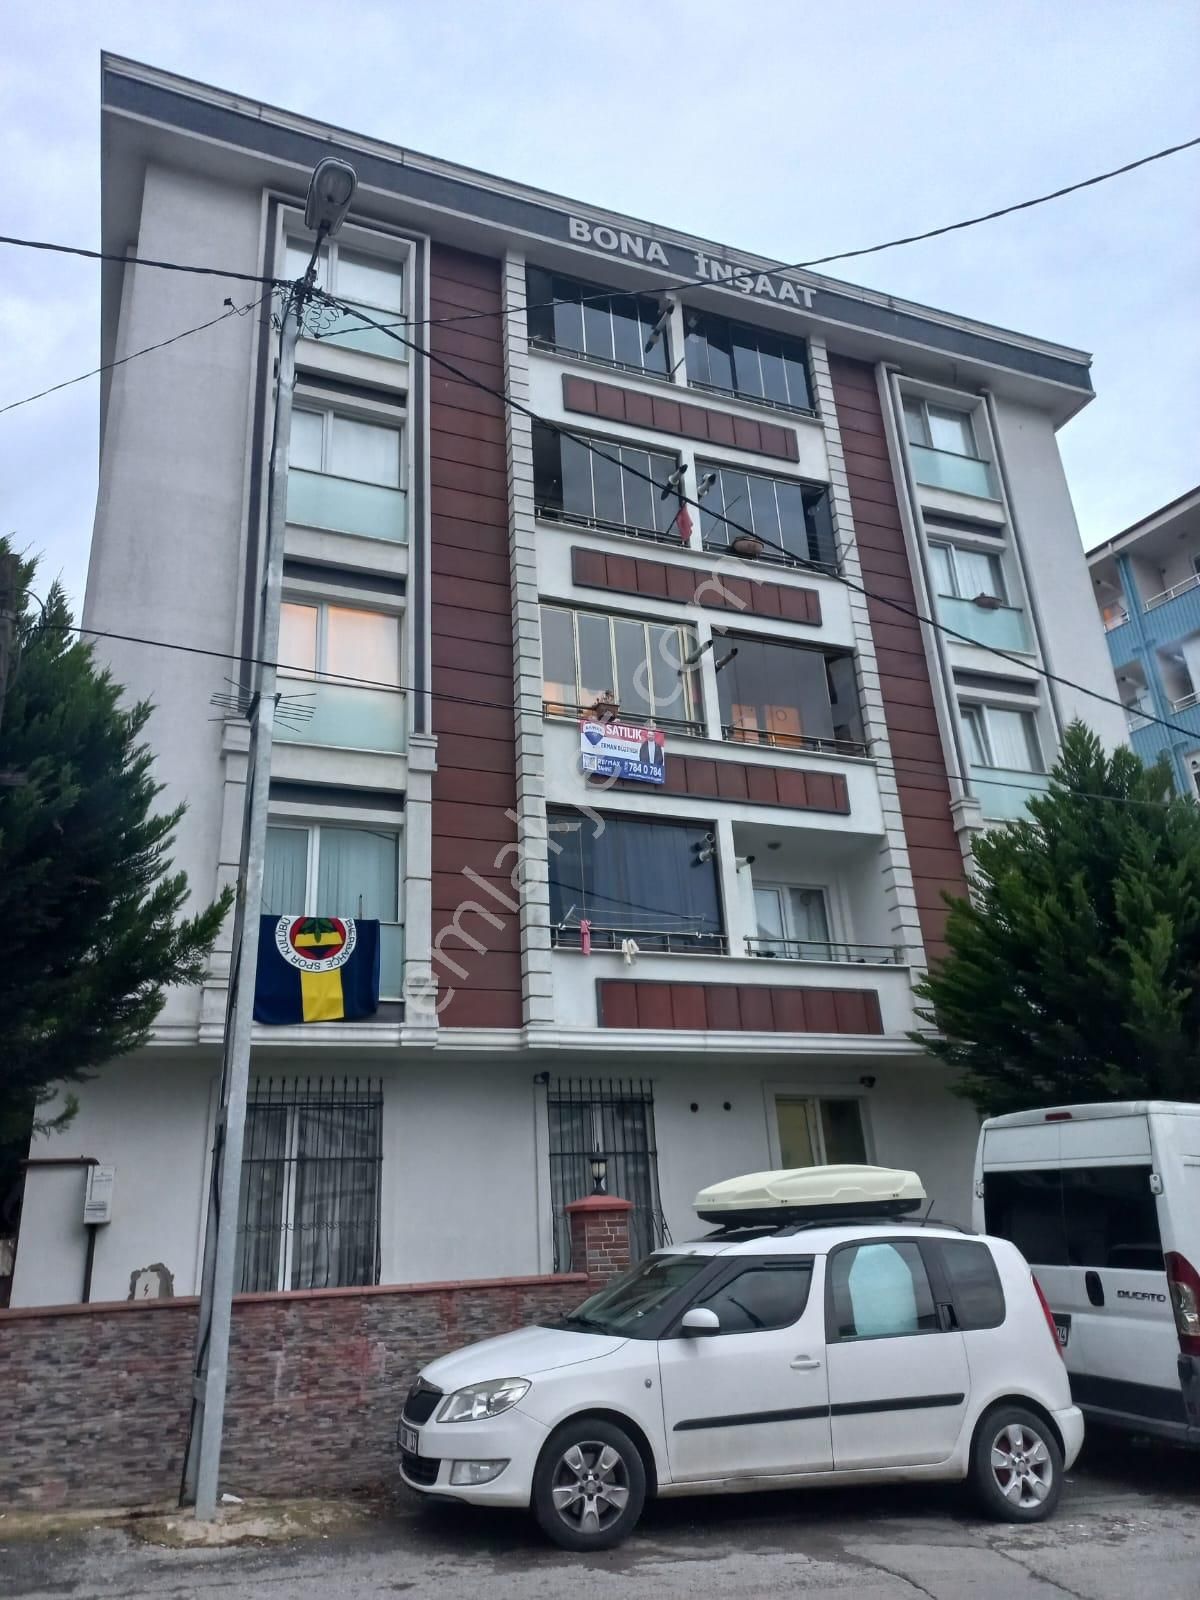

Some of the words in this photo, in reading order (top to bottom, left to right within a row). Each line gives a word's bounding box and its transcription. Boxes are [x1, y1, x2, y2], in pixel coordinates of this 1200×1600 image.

[568, 216, 670, 266] BONA
[694, 252, 817, 309] İNŞAAT
[606, 724, 642, 741] SATILIK
[629, 762, 642, 774] 784
[643, 766, 648, 774] 0
[650, 766, 661, 777] 784
[290, 956, 321, 971] SPOR
[1117, 1290, 1167, 1303] DUCATO
